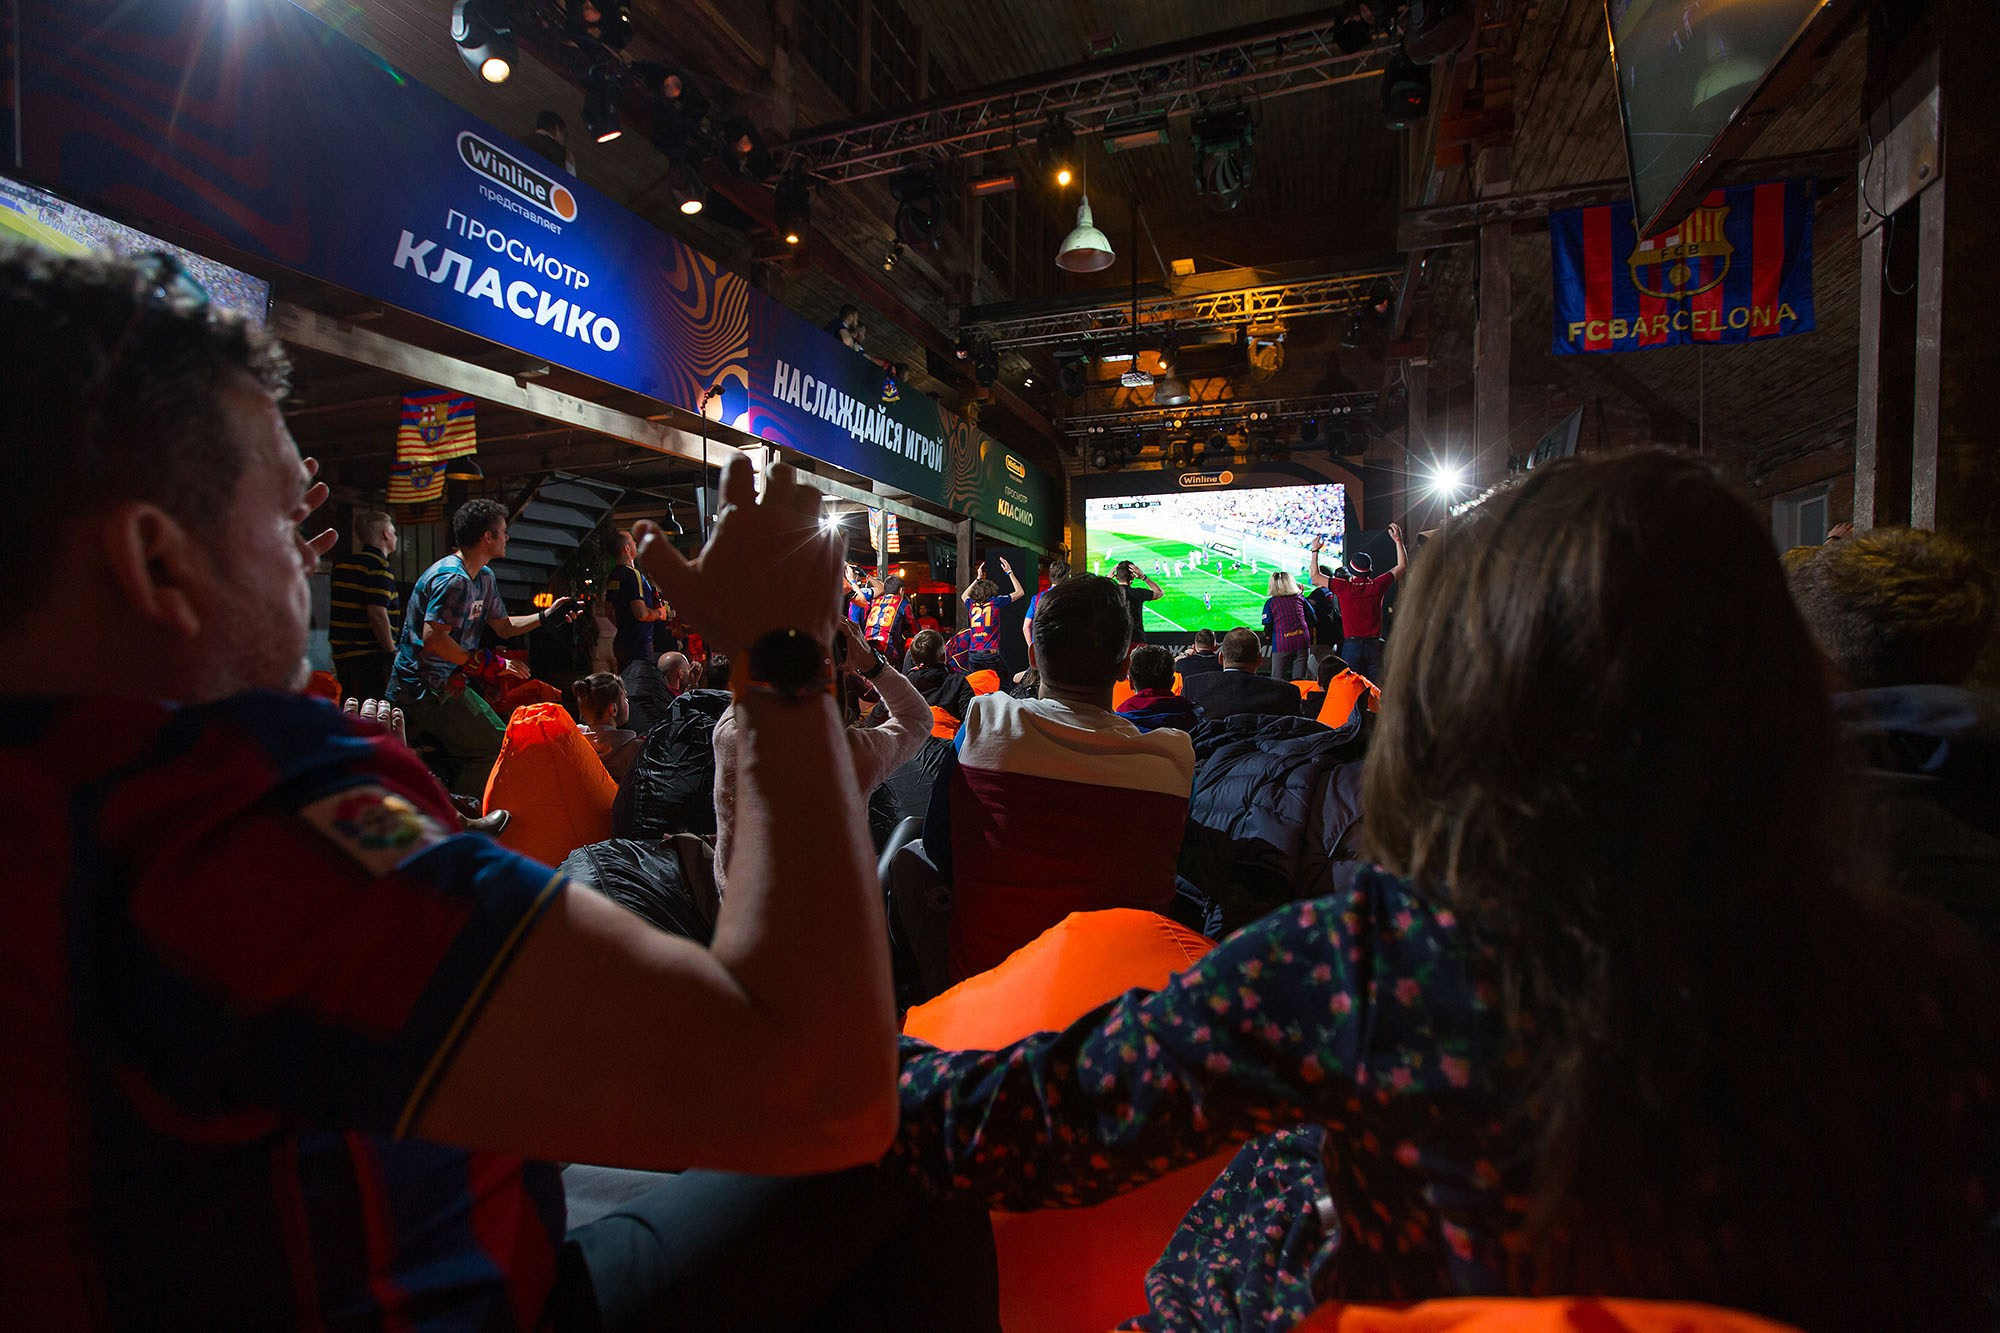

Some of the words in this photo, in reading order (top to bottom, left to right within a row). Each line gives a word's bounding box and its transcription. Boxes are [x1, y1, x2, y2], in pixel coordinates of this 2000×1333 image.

[469, 140, 547, 201] Winline
[479, 184, 562, 235] представляет
[445, 208, 591, 291] ПРОСМОТР
[1660, 243, 1700, 260] FCB
[392, 229, 622, 352] КЛАСИКО
[772, 359, 902, 454] НАСЛАЖДАЙСЯ
[905, 427, 944, 473] ИГРОЙ
[1183, 475, 1218, 484] Winline
[997, 498, 1034, 527] КЛАСИКО
[866, 605, 896, 627] 33
[971, 605, 992, 628] 21
